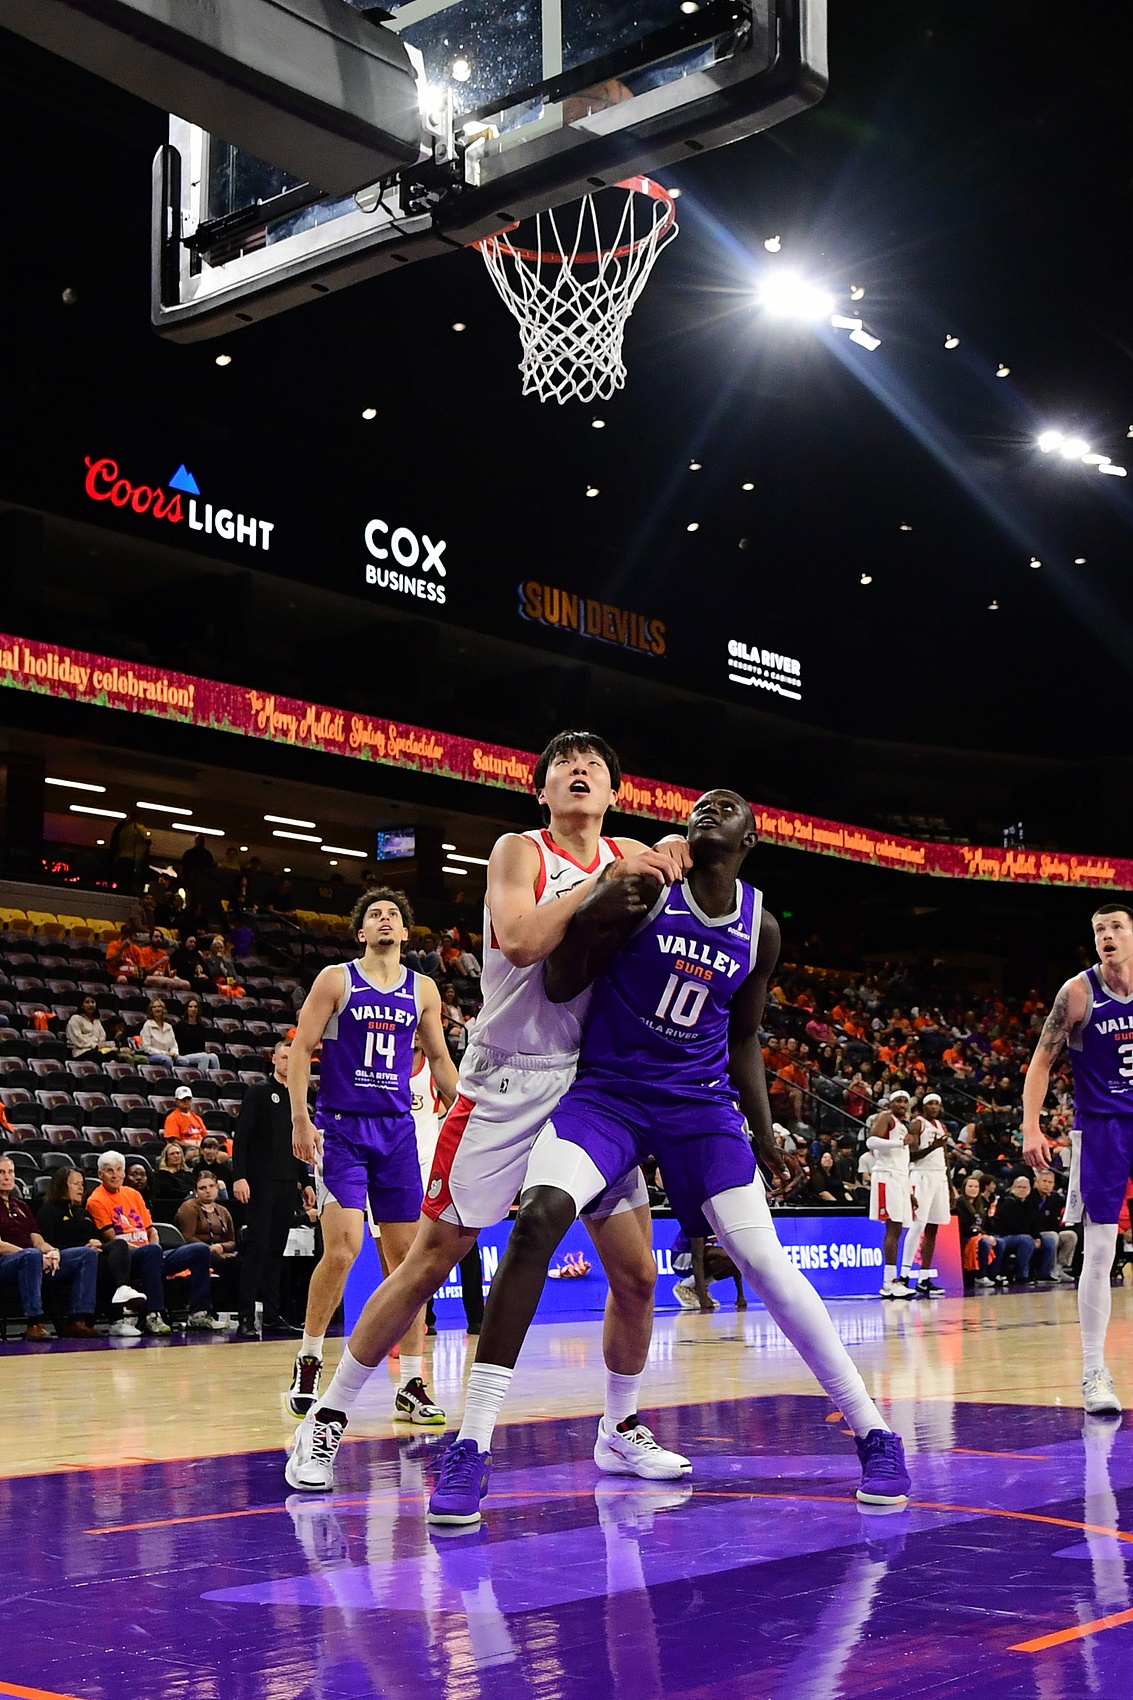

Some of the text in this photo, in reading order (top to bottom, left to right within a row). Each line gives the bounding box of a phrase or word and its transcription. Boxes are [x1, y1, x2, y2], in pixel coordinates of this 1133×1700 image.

[84, 456, 275, 551] Coors LIGHT
[364, 518, 447, 577] COX
[365, 564, 446, 604] BUSINESS
[520, 580, 667, 656] SUN DEVILS
[727, 639, 801, 676] GILA RIVER
[24, 647, 91, 692] holiday
[92, 668, 195, 708] celebration!
[257, 696, 299, 744] Merry
[300, 705, 345, 744] Mullett
[472, 748, 533, 784] Saturday,
[656, 934, 741, 978] VALLEY
[674, 959, 713, 981] SUNS
[350, 1005, 415, 1027] VALLEY
[655, 973, 710, 1027] 10
[367, 1021, 396, 1031] SUNS
[664, 1027, 699, 1040] RIVER
[364, 1031, 396, 1070] 14
[355, 1069, 399, 1080] GILA RIVER
[829, 1243, 883, 1270] $49/mo
